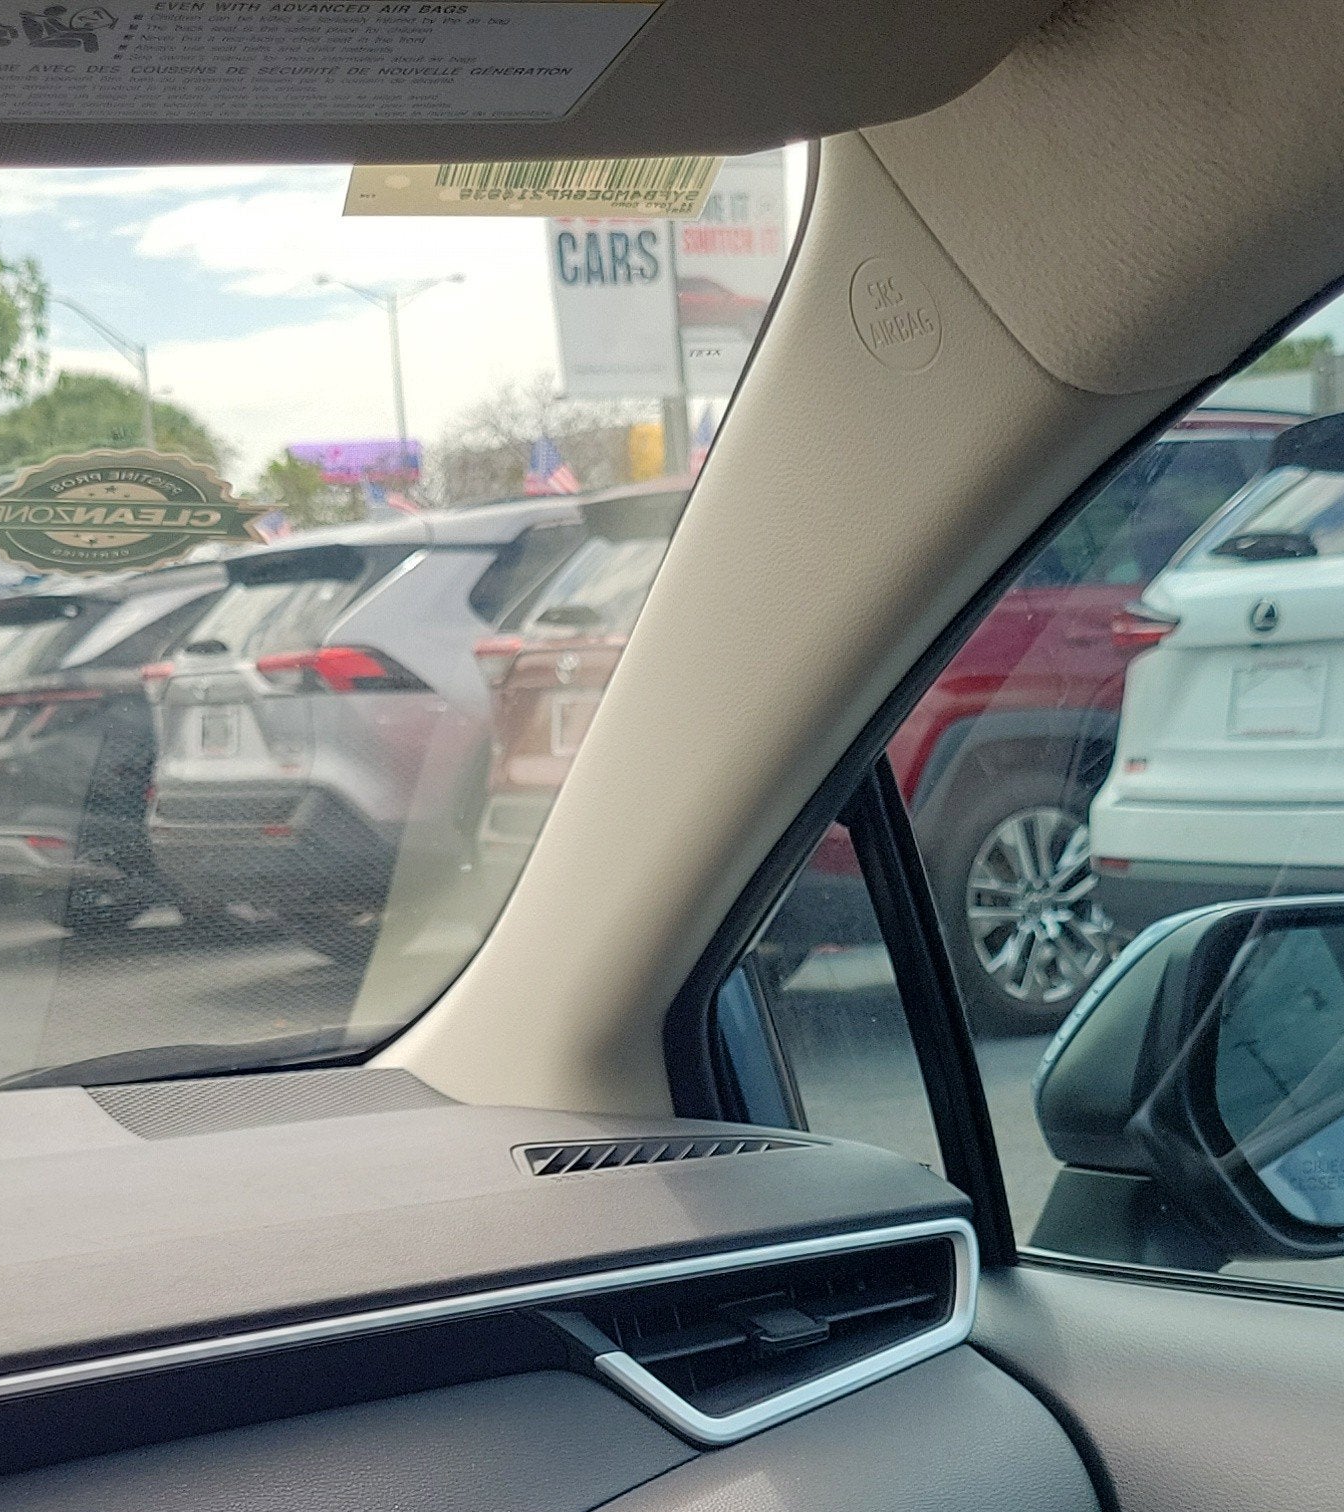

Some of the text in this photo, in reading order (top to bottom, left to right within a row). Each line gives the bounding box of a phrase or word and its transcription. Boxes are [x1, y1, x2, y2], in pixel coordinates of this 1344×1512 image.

[154, 2, 469, 14] EVEN WITH ADVANCED AIR BAGS
[28, 64, 77, 73] AVEC
[86, 64, 122, 74] DES
[130, 64, 219, 74] COUSSINS
[225, 65, 251, 75] DE
[346, 65, 372, 76] DE
[377, 66, 463, 76] NOUVELLE
[557, 229, 660, 286] CARS
[867, 275, 905, 311] SRS
[869, 307, 935, 350] AIRBAG
